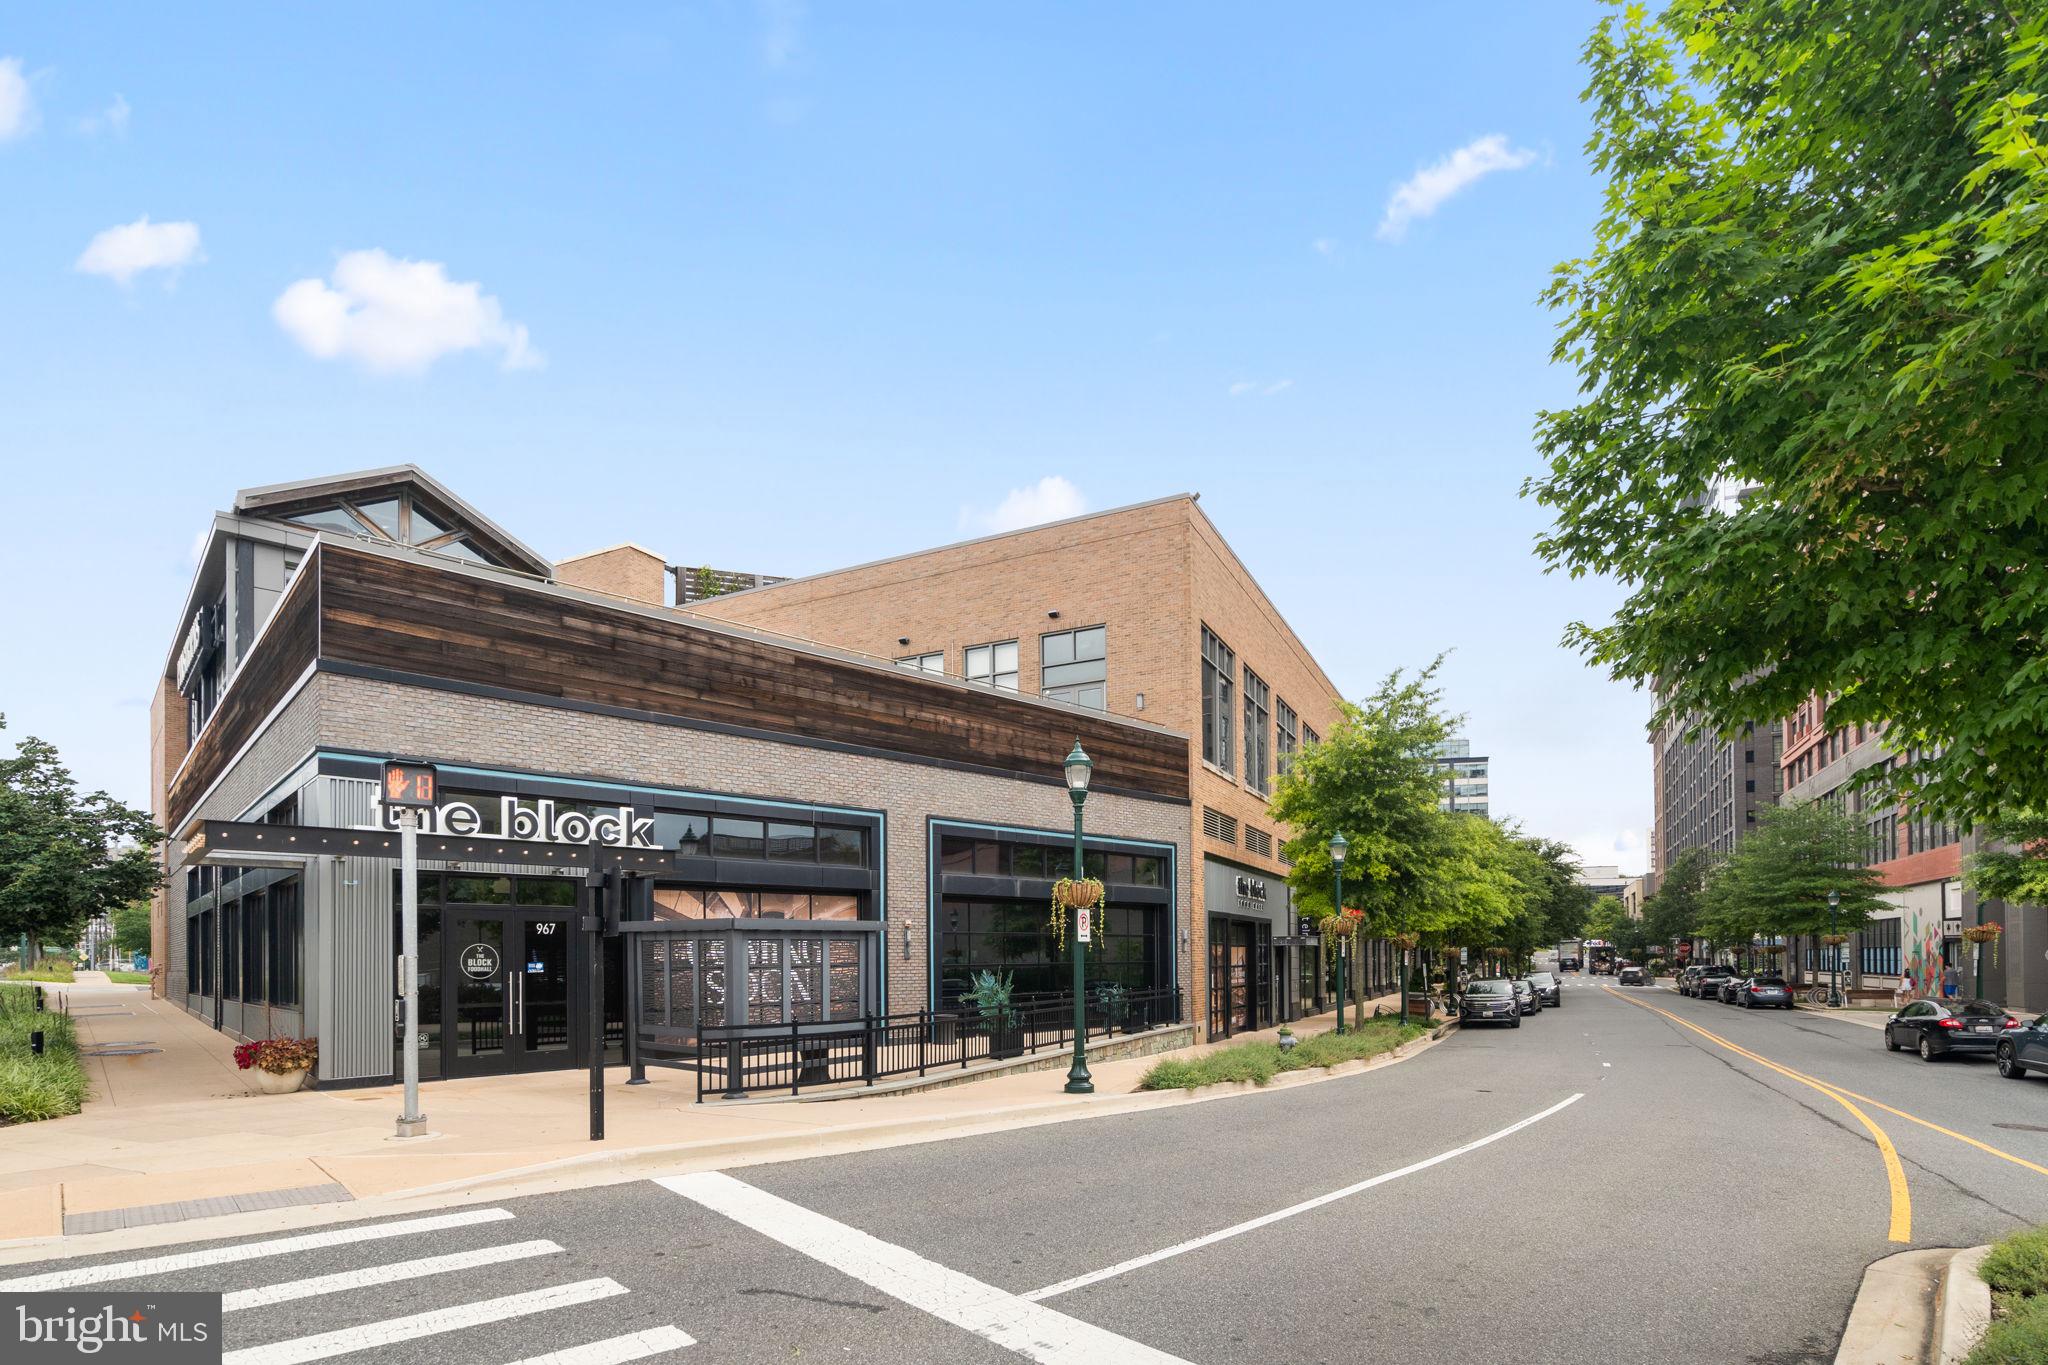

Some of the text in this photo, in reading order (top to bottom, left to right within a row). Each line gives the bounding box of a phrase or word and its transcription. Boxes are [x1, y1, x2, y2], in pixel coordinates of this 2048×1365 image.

[501, 796, 656, 848] block
[536, 923, 556, 935] 967
[467, 958, 492, 966] BLOCK
